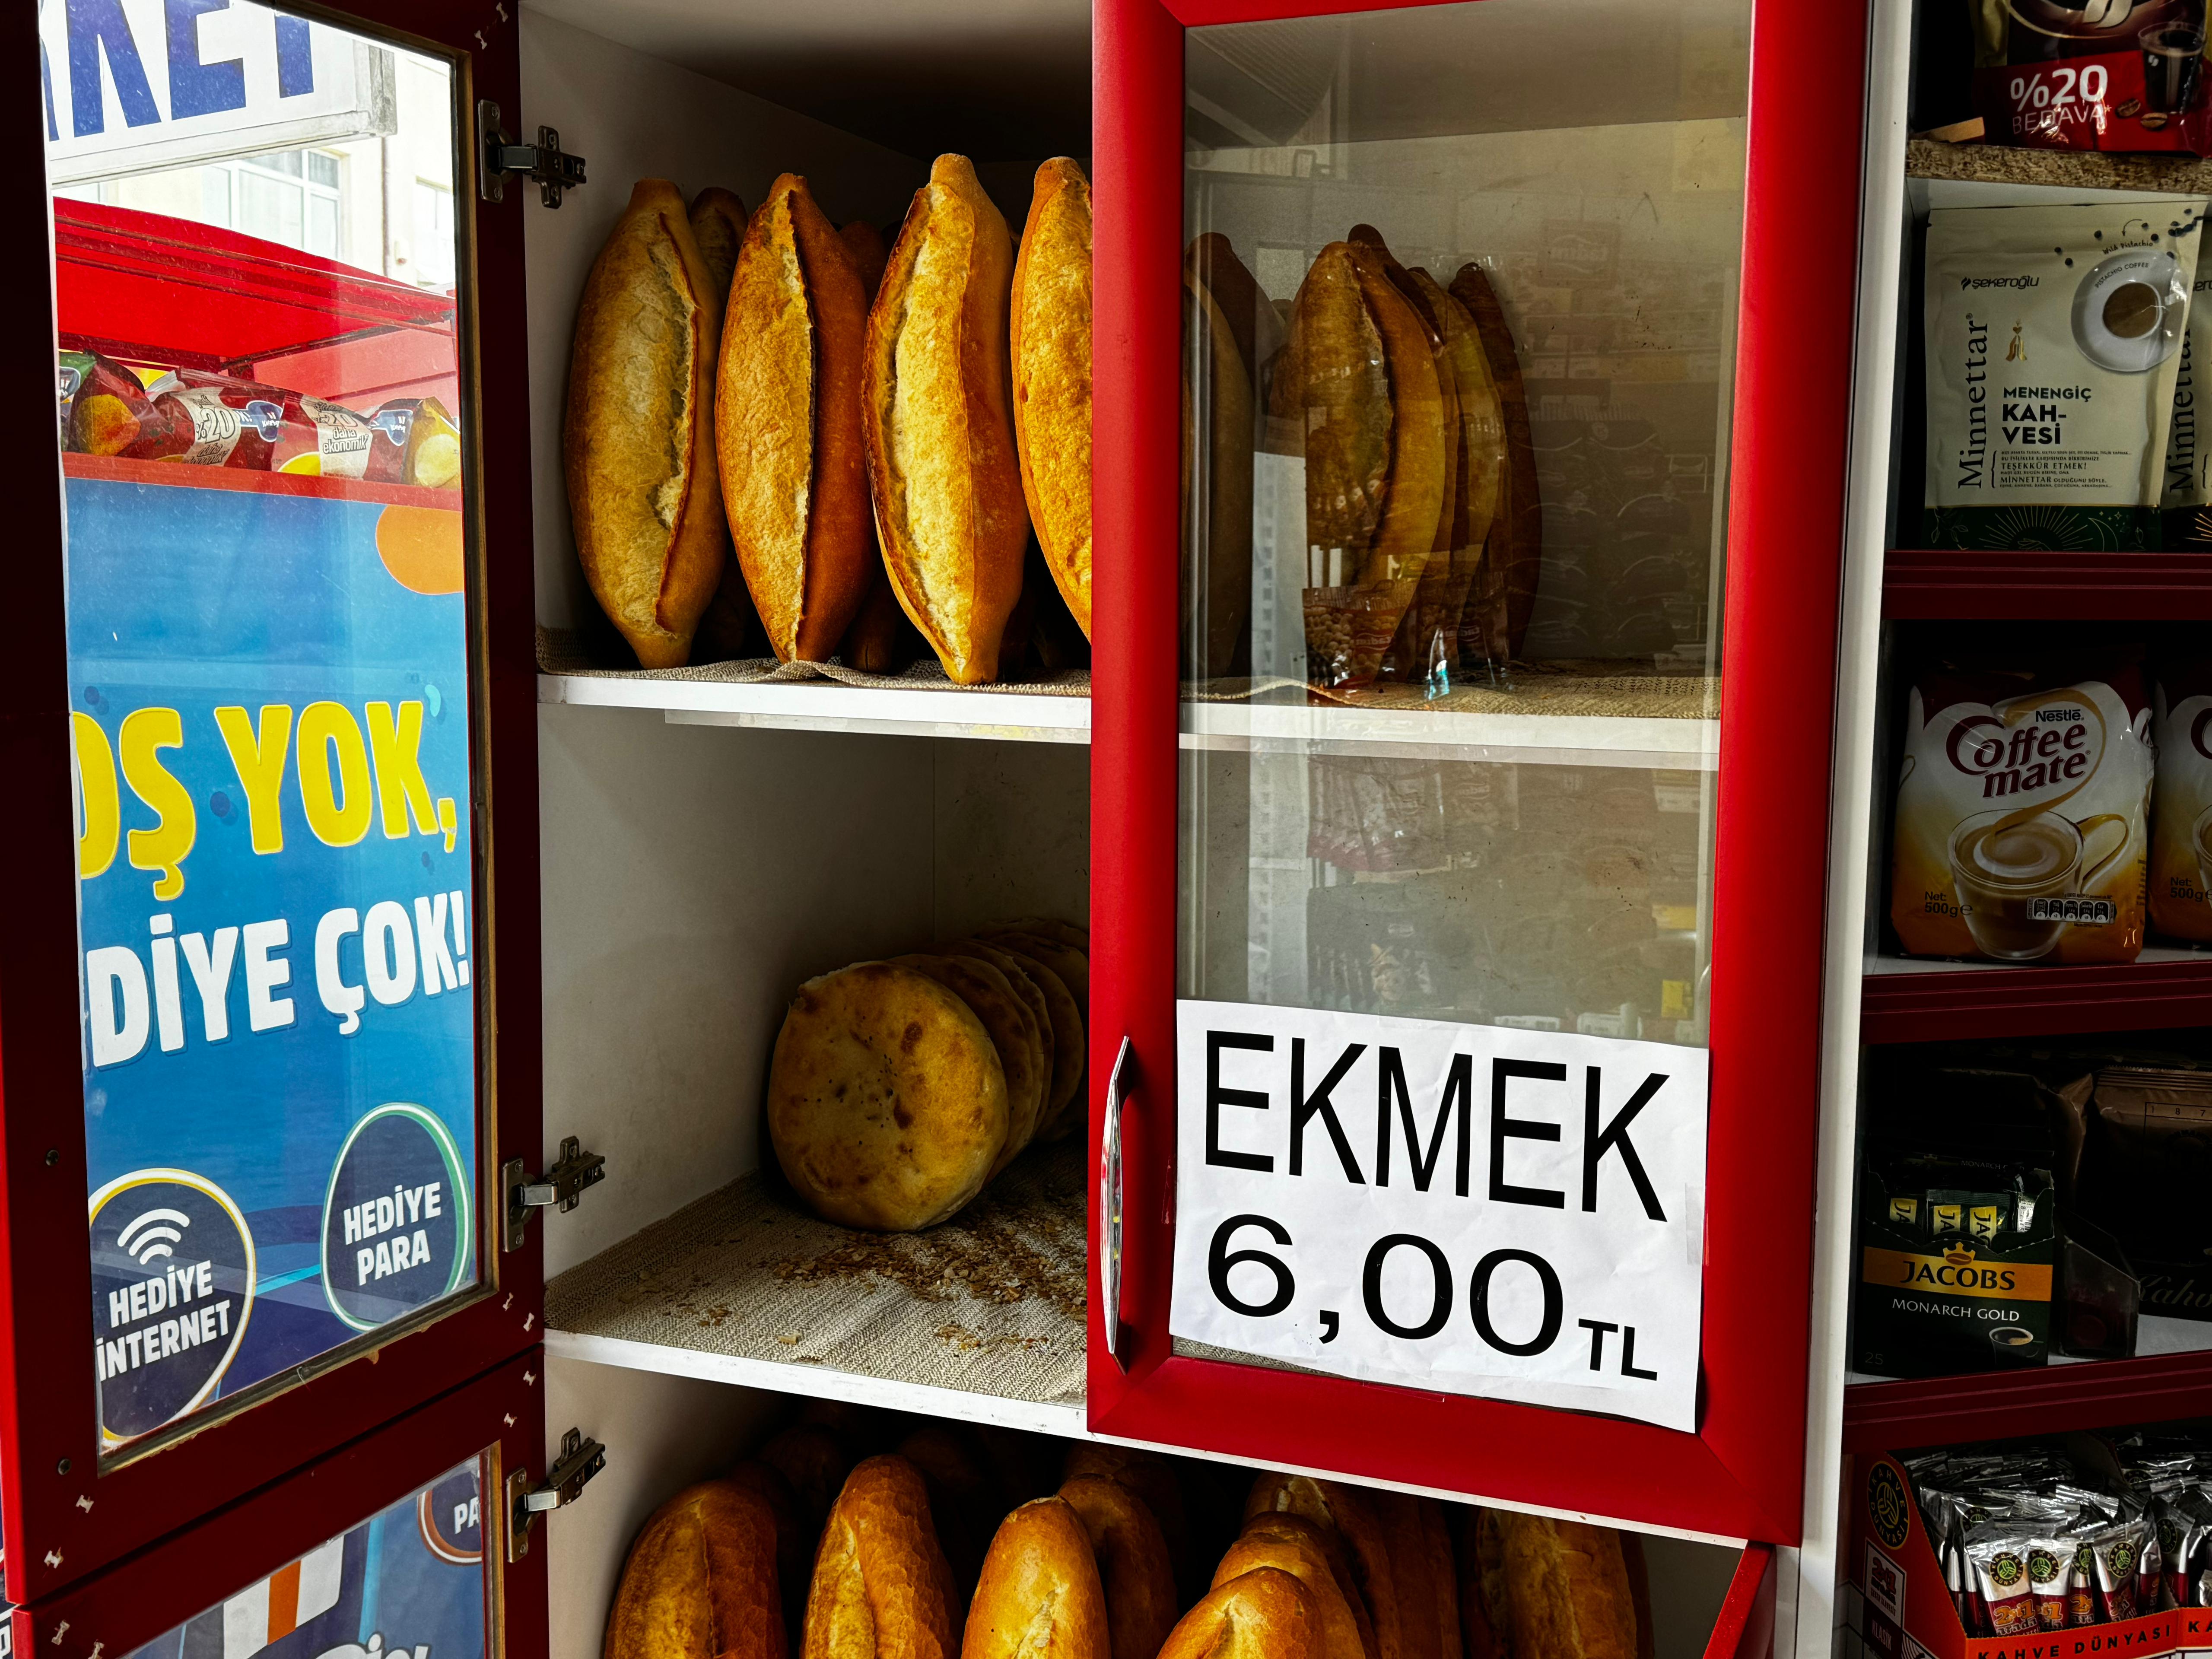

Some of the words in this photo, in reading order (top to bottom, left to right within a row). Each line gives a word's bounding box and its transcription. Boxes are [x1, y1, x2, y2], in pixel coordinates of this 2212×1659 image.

[2010, 64, 2108, 112] %20
[2102, 245, 2118, 254] Wild
[1972, 275, 2039, 289] şekeroğlu
[2095, 267, 2122, 288] PISTACHIO
[1958, 320, 1988, 489] Minnettar
[2003, 385, 2092, 402] MENENGİÇ
[196, 407, 235, 444] %20
[2002, 404, 2067, 422] KAH-
[332, 426, 357, 440] daha
[2002, 423, 2060, 445] VESİ
[2001, 461, 2048, 470] TEŞEKKÜR
[2036, 709, 2081, 722] Nestlé
[1946, 715, 2087, 775] Coffee
[213, 700, 457, 855] YOK,
[1983, 753, 2088, 798] mate
[1925, 891, 1947, 901] Net:
[2171, 877, 2192, 887] Net:
[86, 912, 296, 1068] DİYE
[314, 890, 470, 1036] ÇOK!
[1205, 1030, 1670, 1222] EKMEK
[1961, 1160, 2001, 1170] MONARCH
[344, 1182, 442, 1245] HEDİYE
[357, 1230, 431, 1286] PARA
[1900, 1260, 2016, 1291] JACOBS
[108, 1260, 213, 1328] HEDİYE
[1208, 1214, 1564, 1357] 6,00
[1578, 1319, 1658, 1381] TL
[1892, 1298, 1972, 1318] MONARCH
[1977, 1307, 2020, 1322] GOLD
[96, 1300, 231, 1382] İNTERNET
[1864, 1352, 1884, 1366] 25
[1871, 1468, 1906, 1508] KAHVE
[1871, 1502, 1905, 1544] DÜNYASI
[2031, 1551, 2058, 1566] AHVE
[1872, 1618, 1892, 1652] KLASİK
[1978, 1645, 2060, 1659] KAHVE
[2075, 1624, 2171, 1655] DÜNYASI
